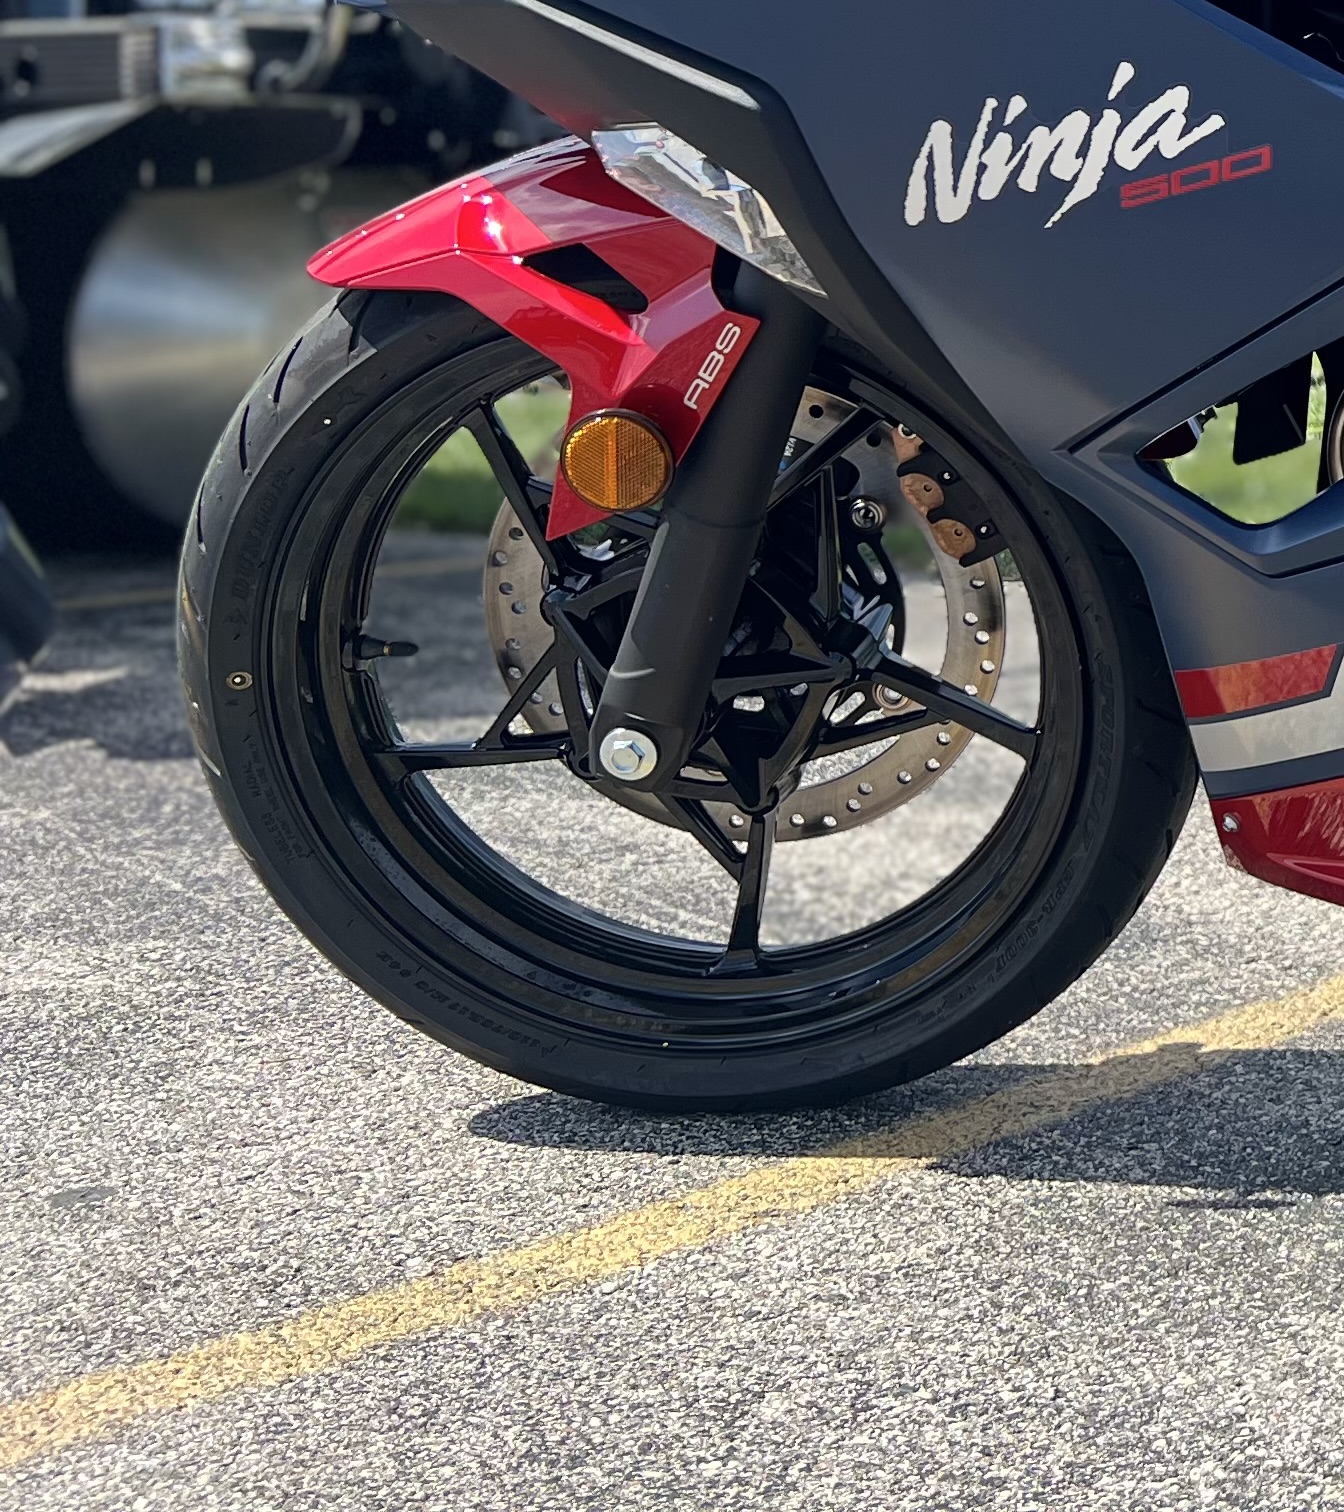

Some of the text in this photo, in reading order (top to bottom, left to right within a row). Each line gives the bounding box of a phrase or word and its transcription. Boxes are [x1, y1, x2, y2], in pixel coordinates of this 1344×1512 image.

[903, 60, 1227, 230] Ninja
[1119, 143, 1272, 209] 500
[683, 322, 741, 410] ABS
